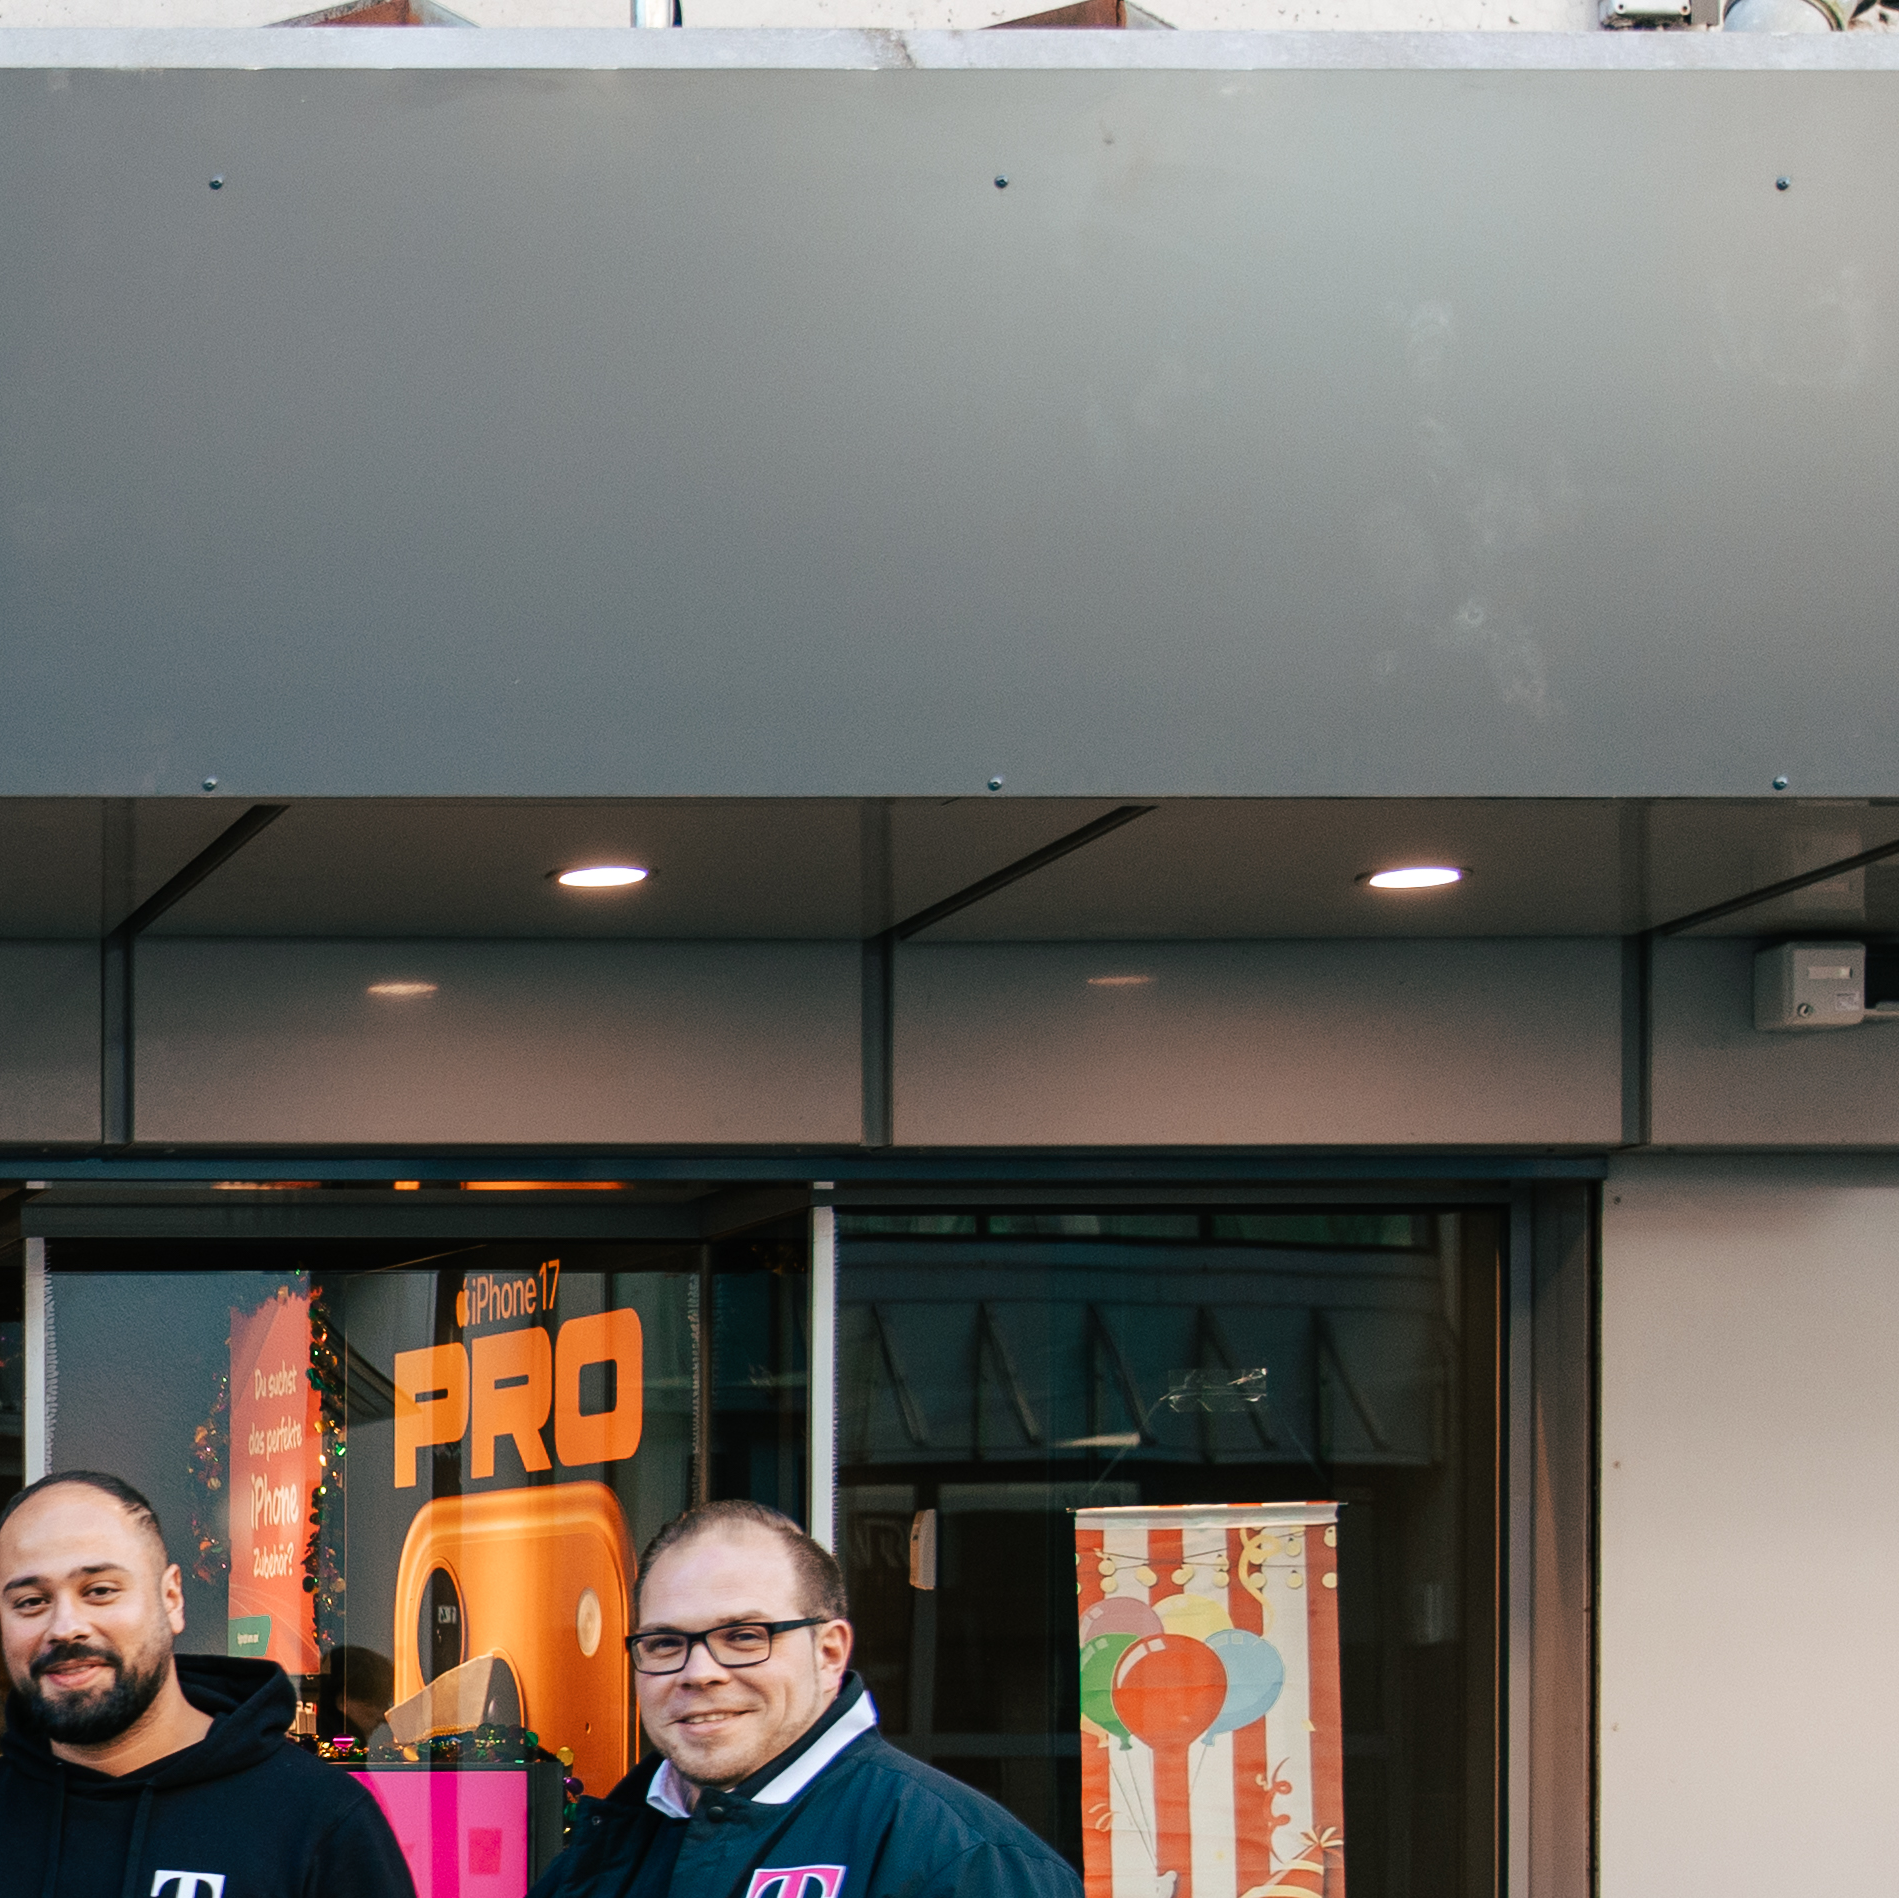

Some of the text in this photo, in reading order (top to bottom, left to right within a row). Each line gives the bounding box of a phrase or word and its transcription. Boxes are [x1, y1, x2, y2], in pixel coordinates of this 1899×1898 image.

[471, 1259, 560, 1326] iPhone 17
[255, 1359, 298, 1400] Du suchst
[394, 1307, 644, 1489] PRO
[248, 1415, 303, 1462] das perfekte
[250, 1472, 300, 1531] iPhone
[253, 1541, 295, 1580] Zubehör?
